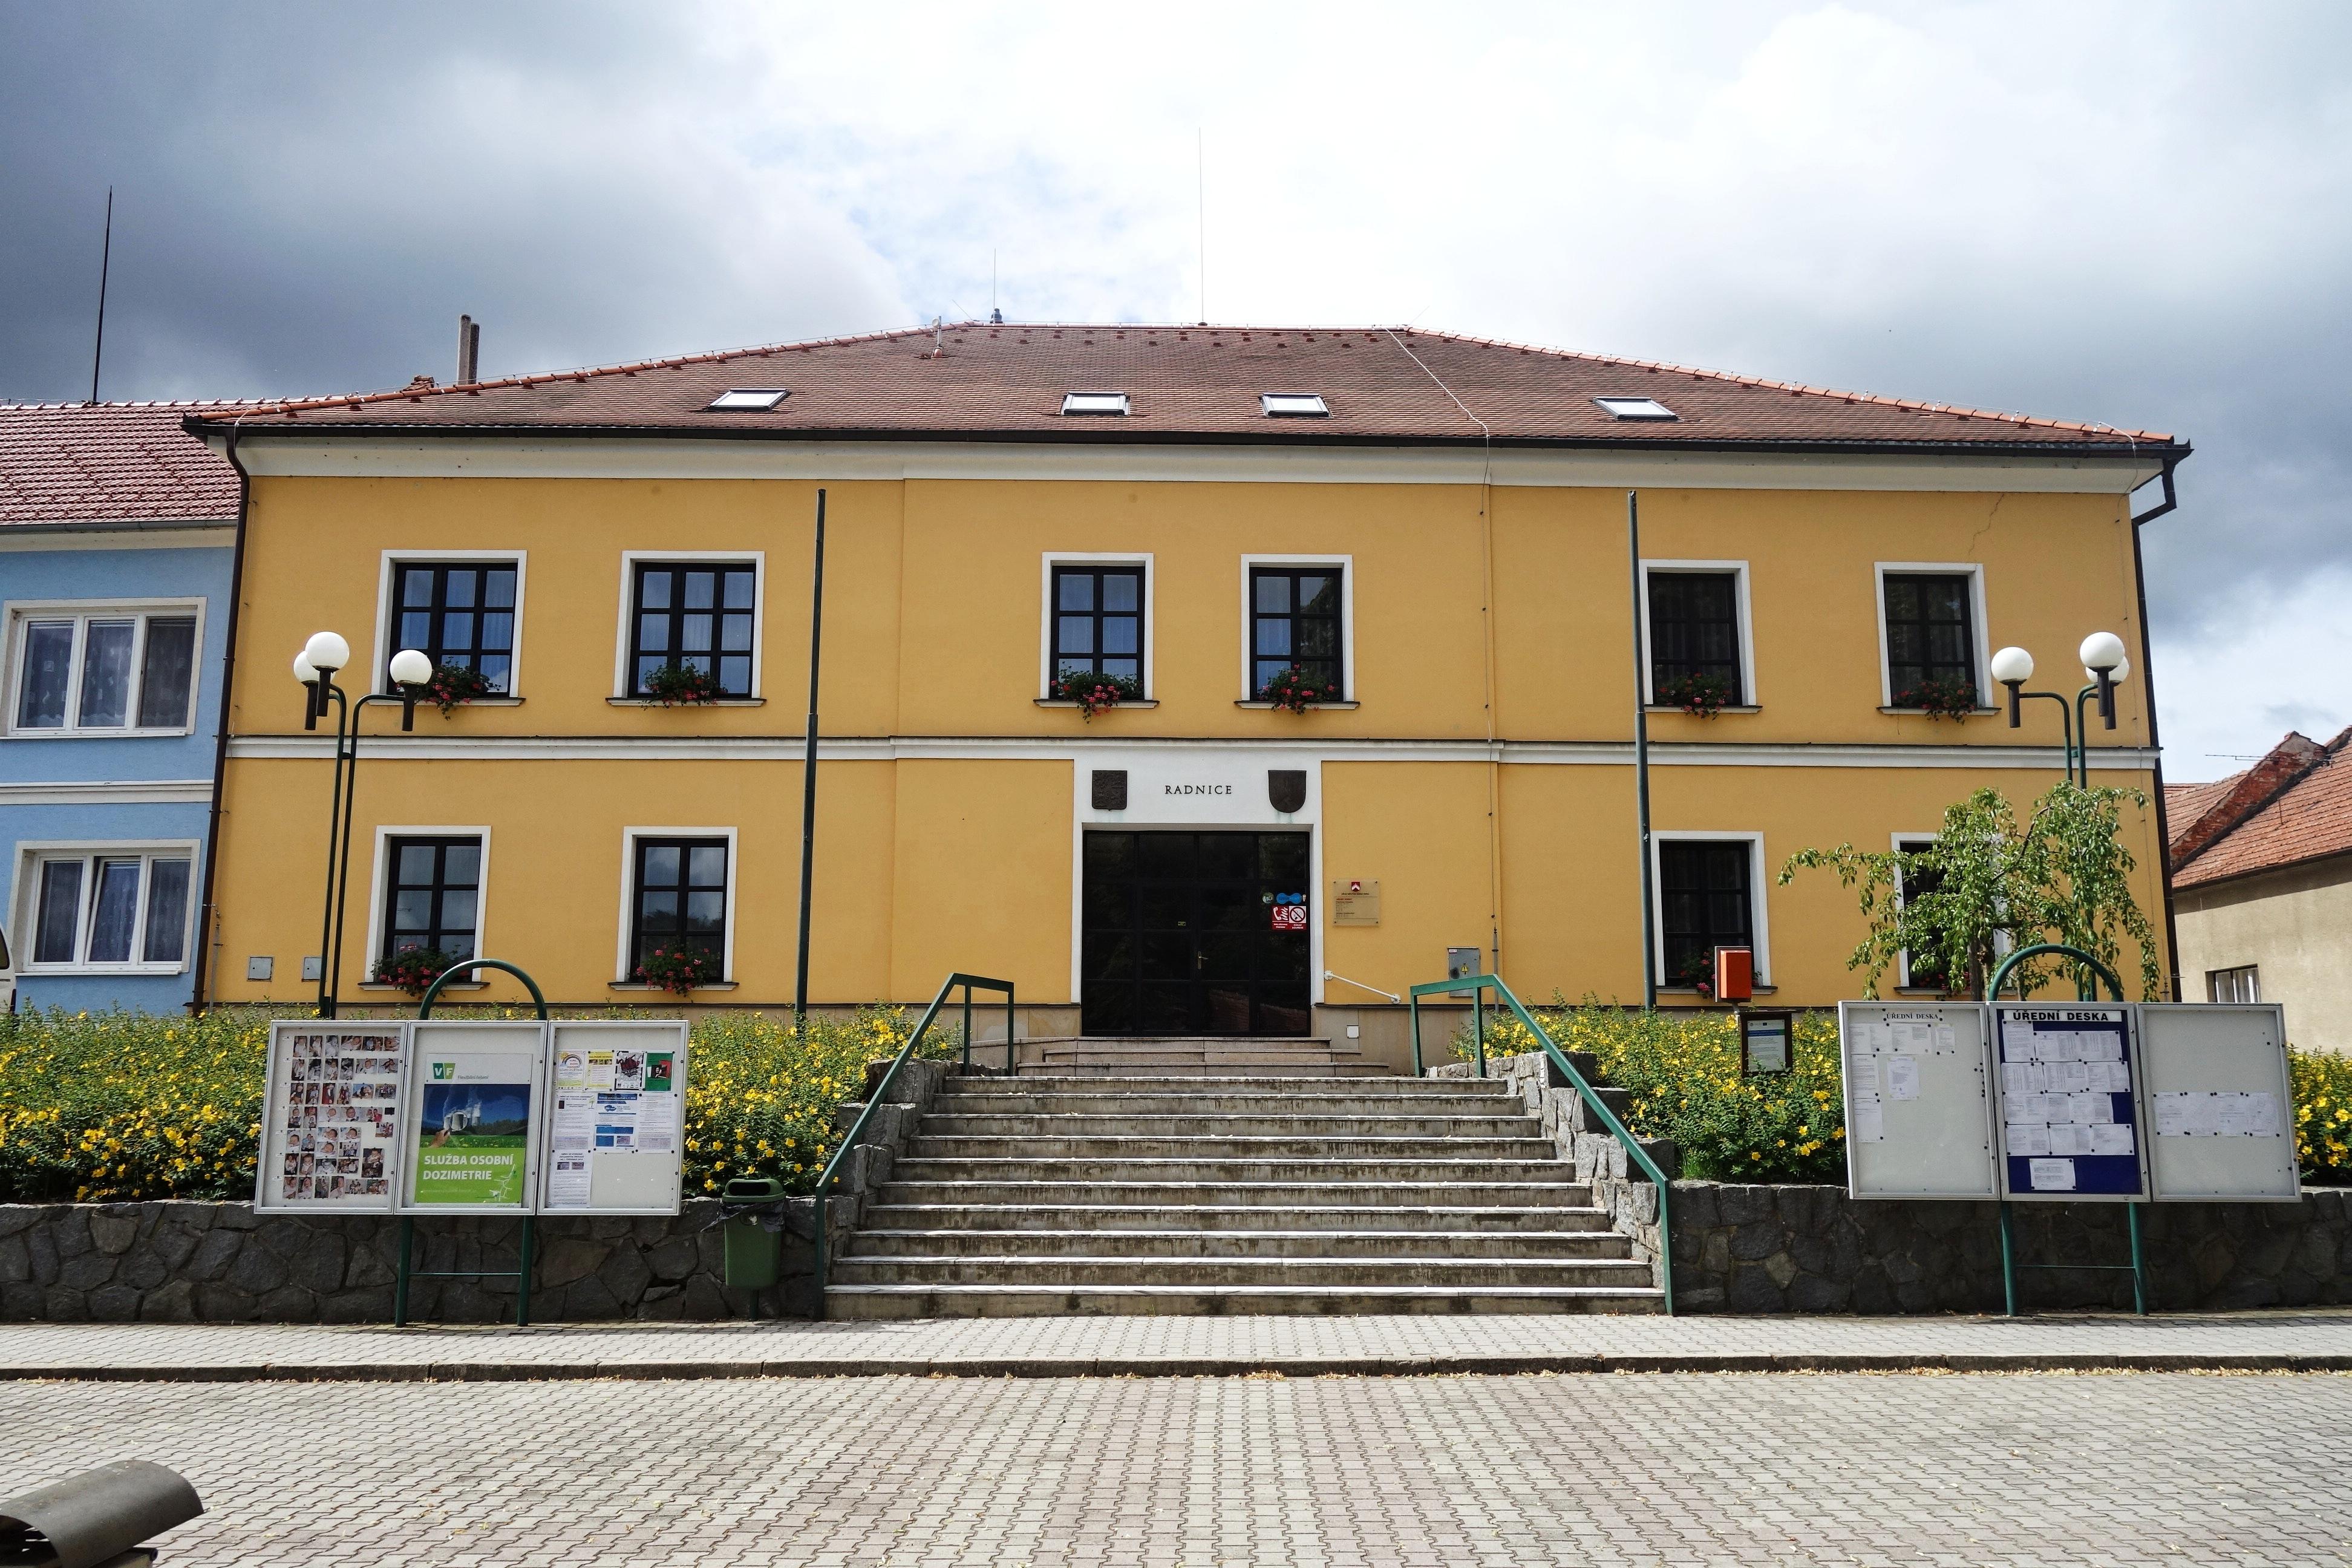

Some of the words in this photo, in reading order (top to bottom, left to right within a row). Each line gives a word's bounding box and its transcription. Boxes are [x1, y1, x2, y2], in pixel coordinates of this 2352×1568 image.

[1165, 785, 1232, 794] RADNICE
[2013, 1010, 2060, 1021] ÚŘEDNÍ
[2066, 1012, 2109, 1021] DESKA
[434, 1067, 453, 1076] VF
[424, 1154, 467, 1165] SLUŽBA
[470, 1154, 514, 1165] OSOBNÍ
[423, 1170, 492, 1180] DOZIMETRIE
